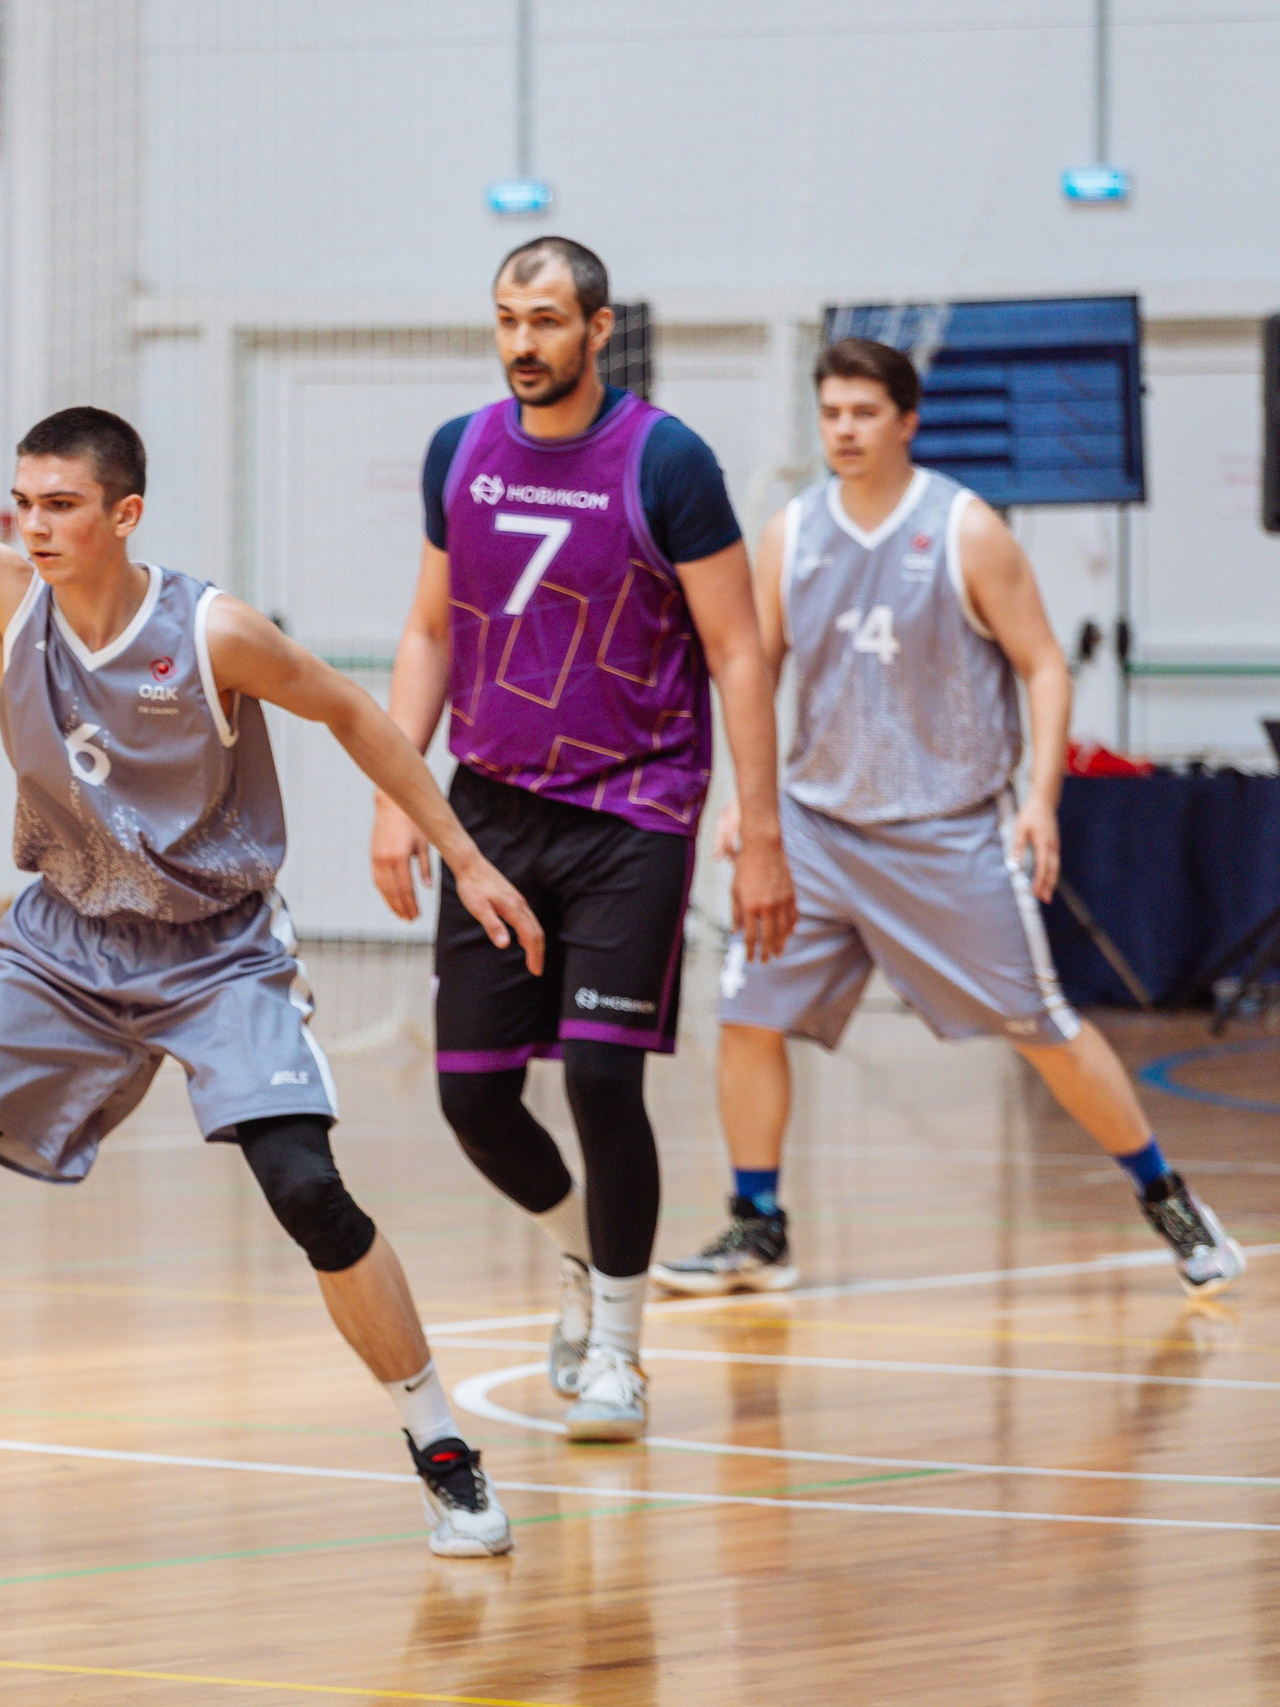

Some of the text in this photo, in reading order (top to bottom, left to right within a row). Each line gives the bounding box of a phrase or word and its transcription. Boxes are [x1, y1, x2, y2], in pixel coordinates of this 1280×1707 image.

[506, 483, 610, 510] НОВИКОМ
[494, 512, 572, 616] 7
[835, 604, 900, 665] 14
[64, 723, 111, 787] 6
